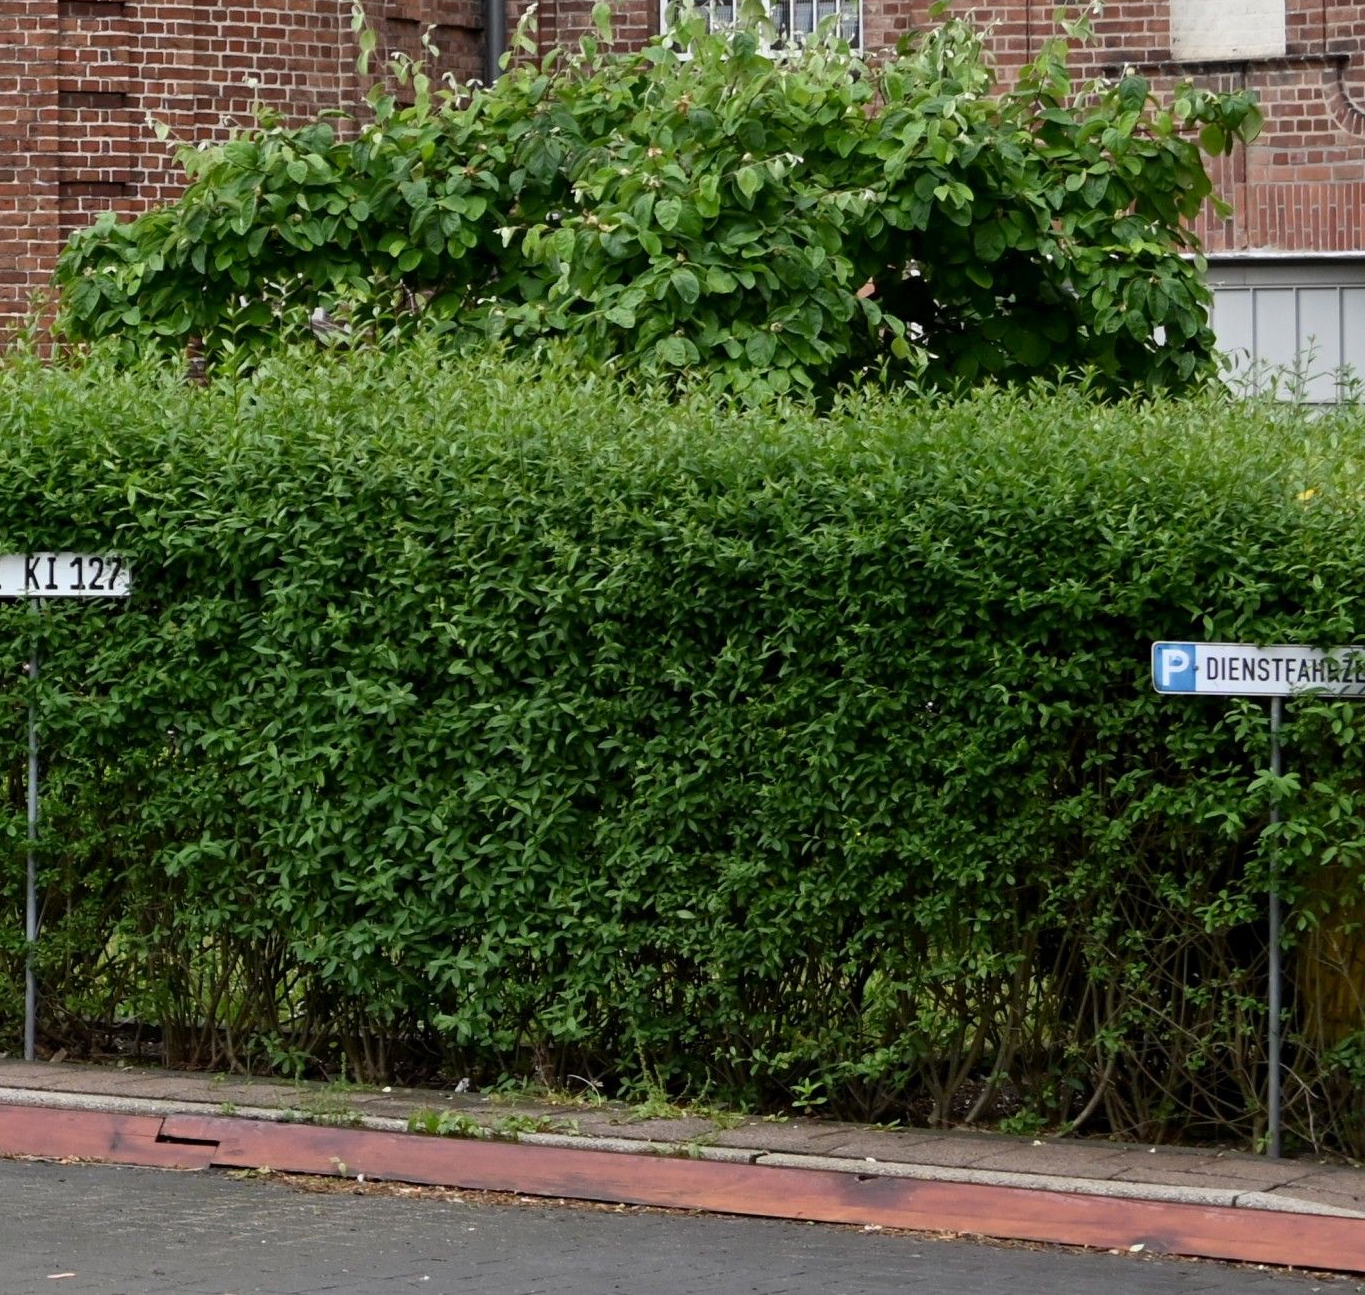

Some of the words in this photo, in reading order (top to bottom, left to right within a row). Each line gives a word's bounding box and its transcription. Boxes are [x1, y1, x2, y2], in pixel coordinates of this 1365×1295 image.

[25, 556, 59, 590] KI
[69, 556, 123, 590] 127
[1162, 649, 1190, 686] P
